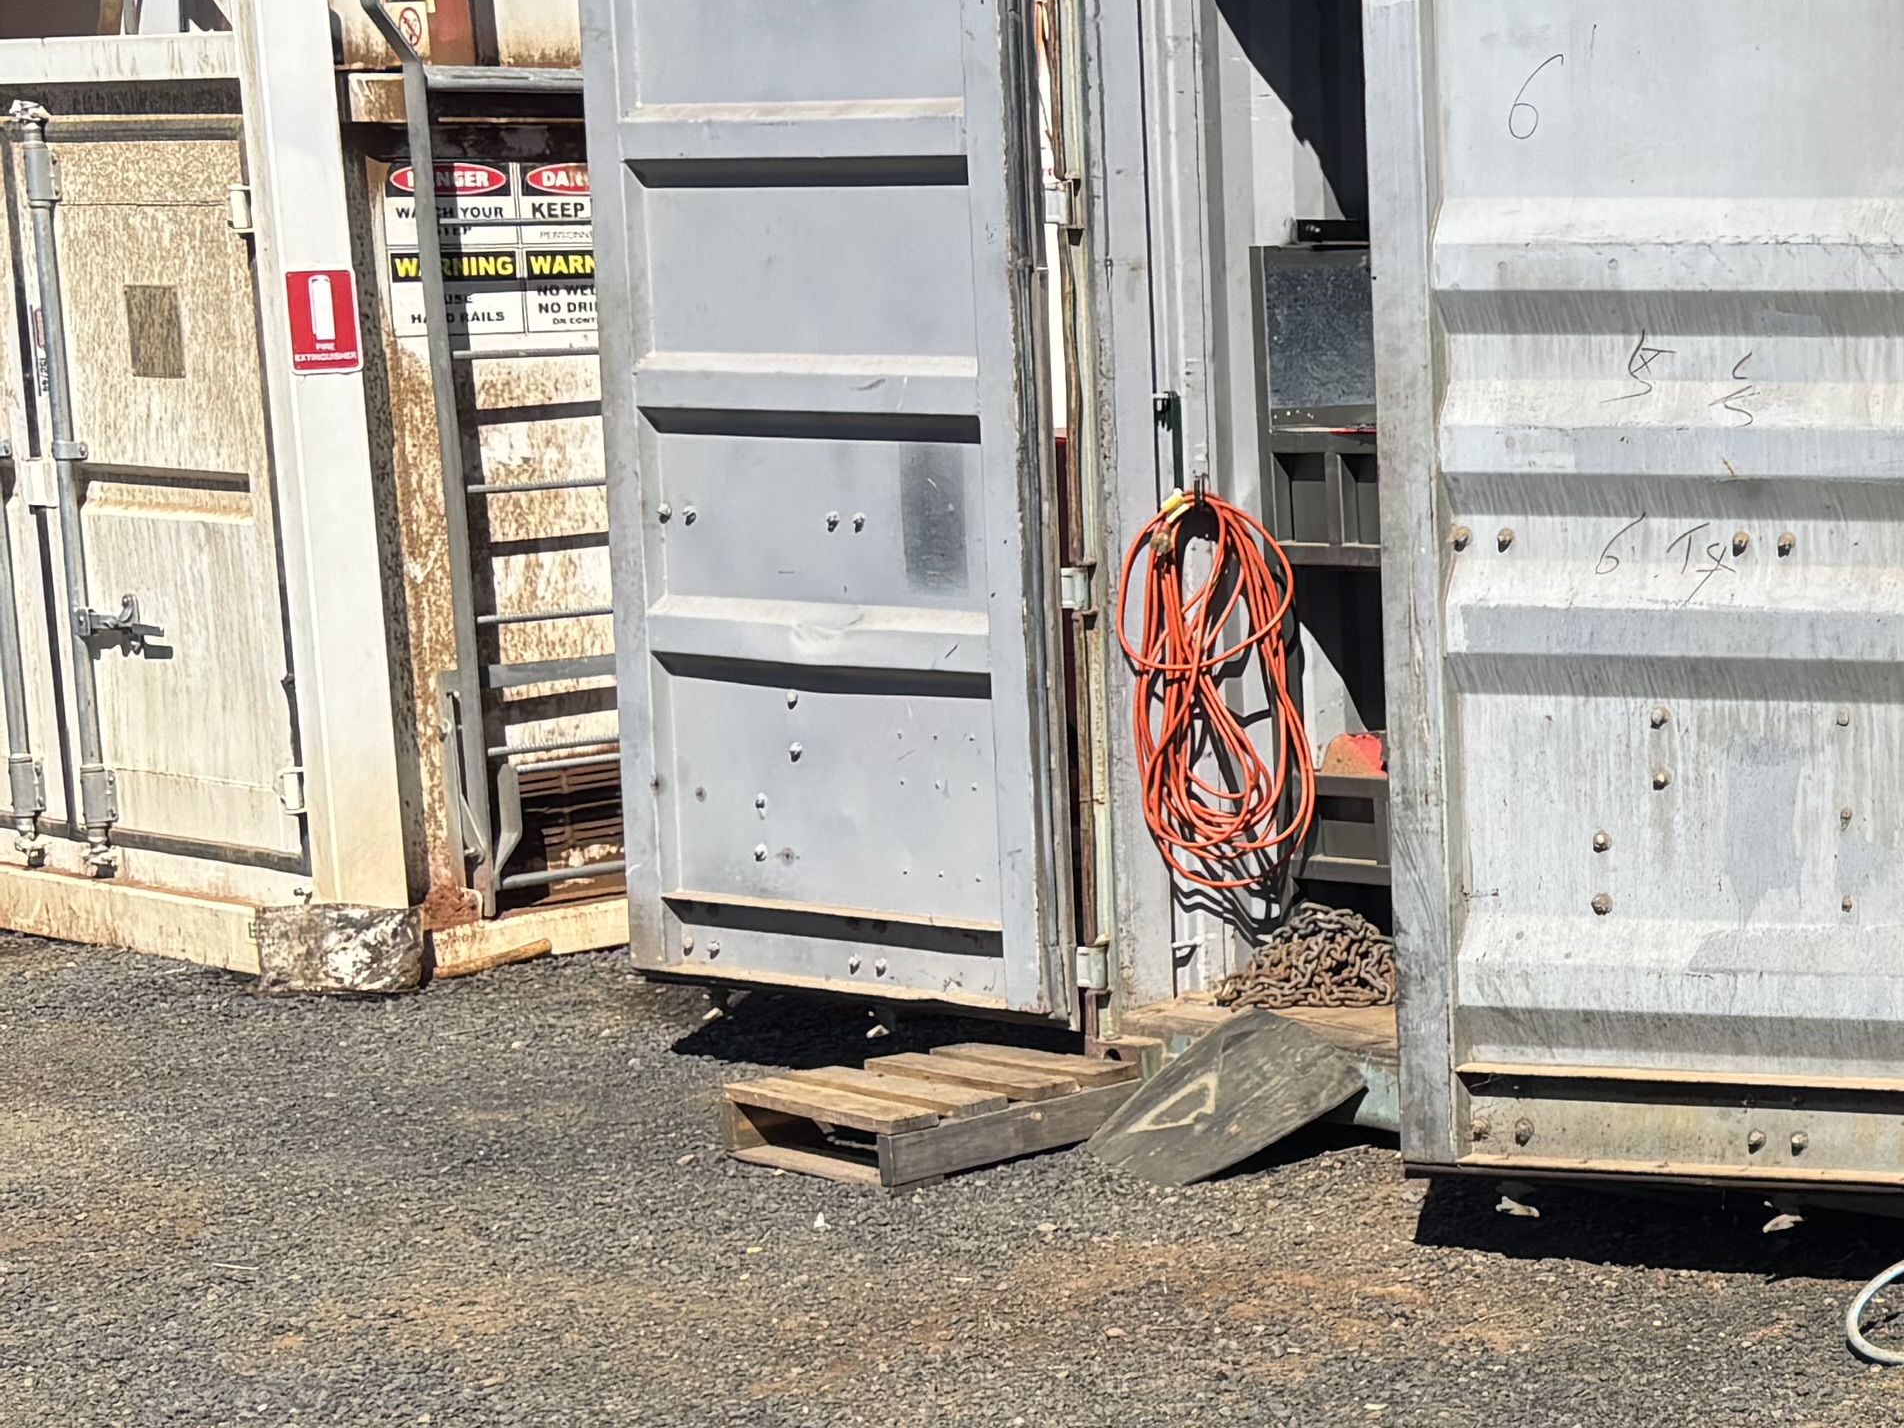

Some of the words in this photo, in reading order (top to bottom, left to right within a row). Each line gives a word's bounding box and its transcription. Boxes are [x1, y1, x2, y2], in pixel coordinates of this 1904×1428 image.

[460, 206, 504, 219] YOUR
[531, 202, 585, 219] KEEP
[394, 256, 514, 278] WRNING
[538, 301, 561, 314] NO
[460, 311, 505, 322] RAILS
